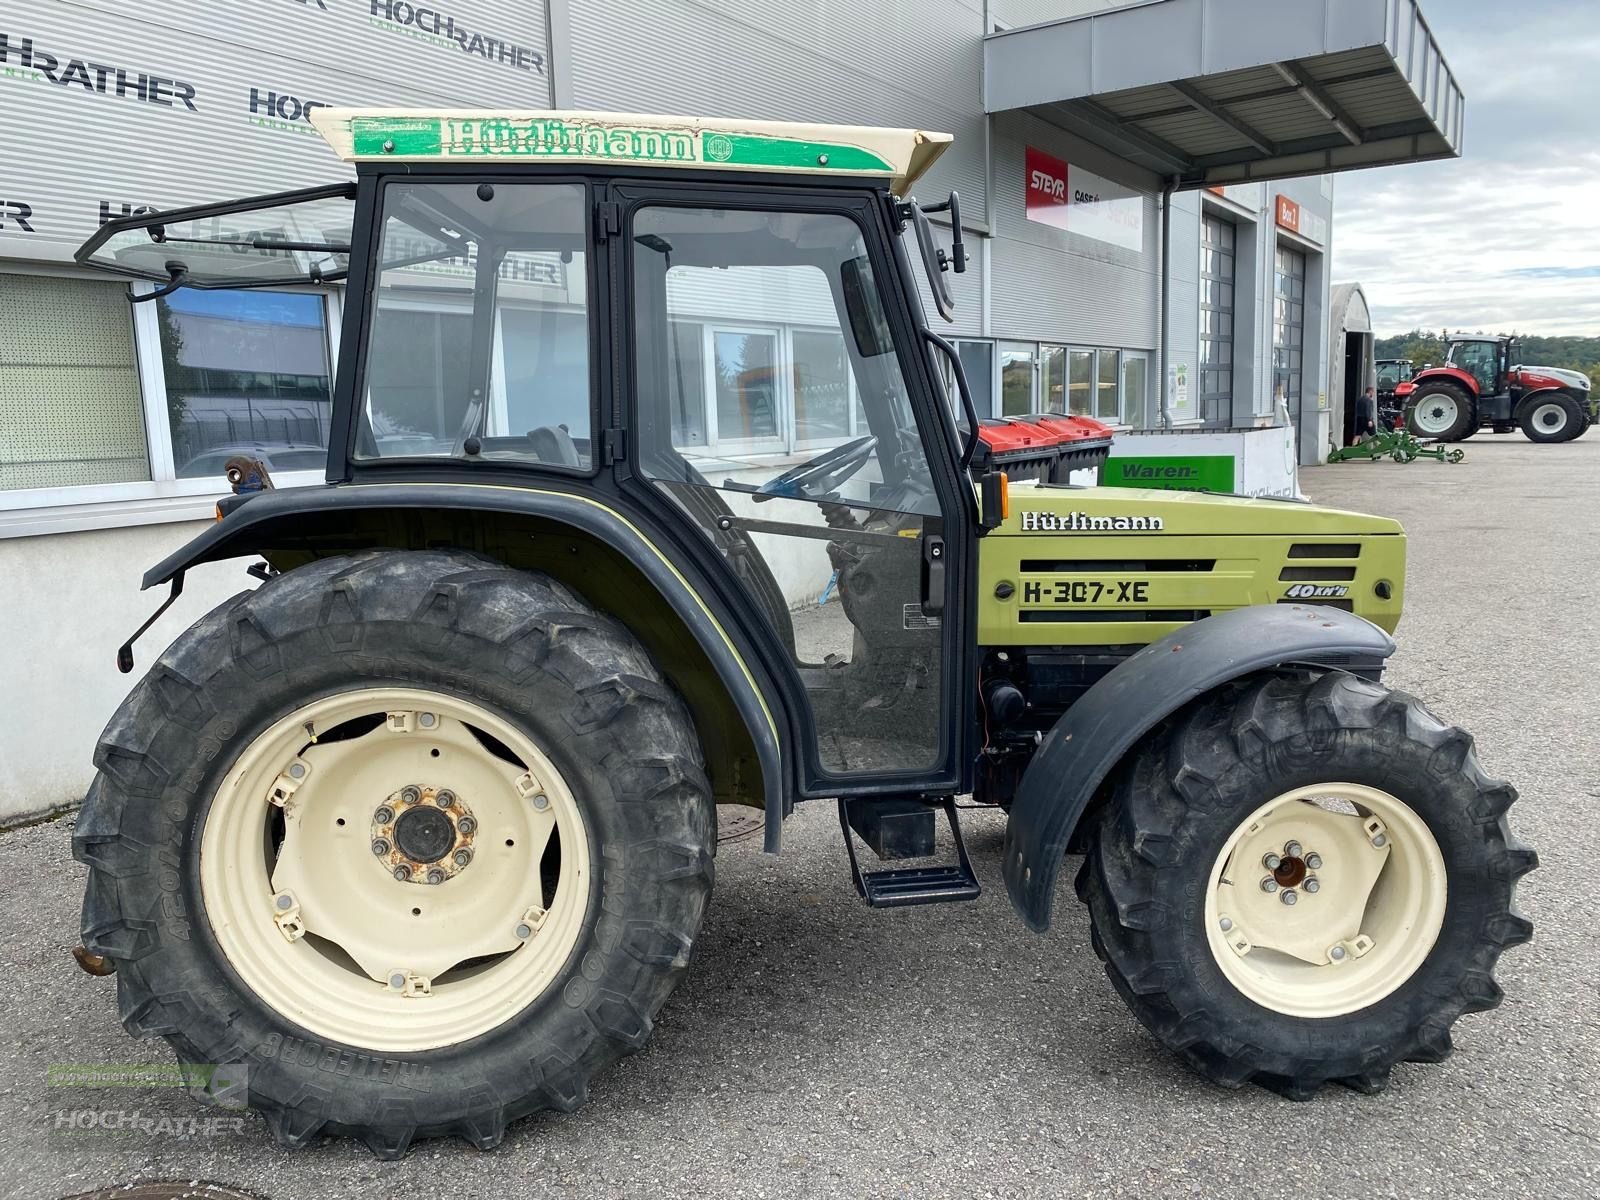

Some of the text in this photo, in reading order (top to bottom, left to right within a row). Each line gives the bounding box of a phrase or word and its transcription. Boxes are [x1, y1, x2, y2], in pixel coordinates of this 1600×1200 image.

[370, 0, 544, 75] HOCHRATHER
[450, 118, 697, 161] Hürlimann
[1031, 170, 1064, 198] STEYR
[1122, 463, 1199, 479] Waren-
[1021, 511, 1164, 531] Hürlimann
[1024, 581, 1149, 603] H-307-XE
[1287, 584, 1315, 598] 40
